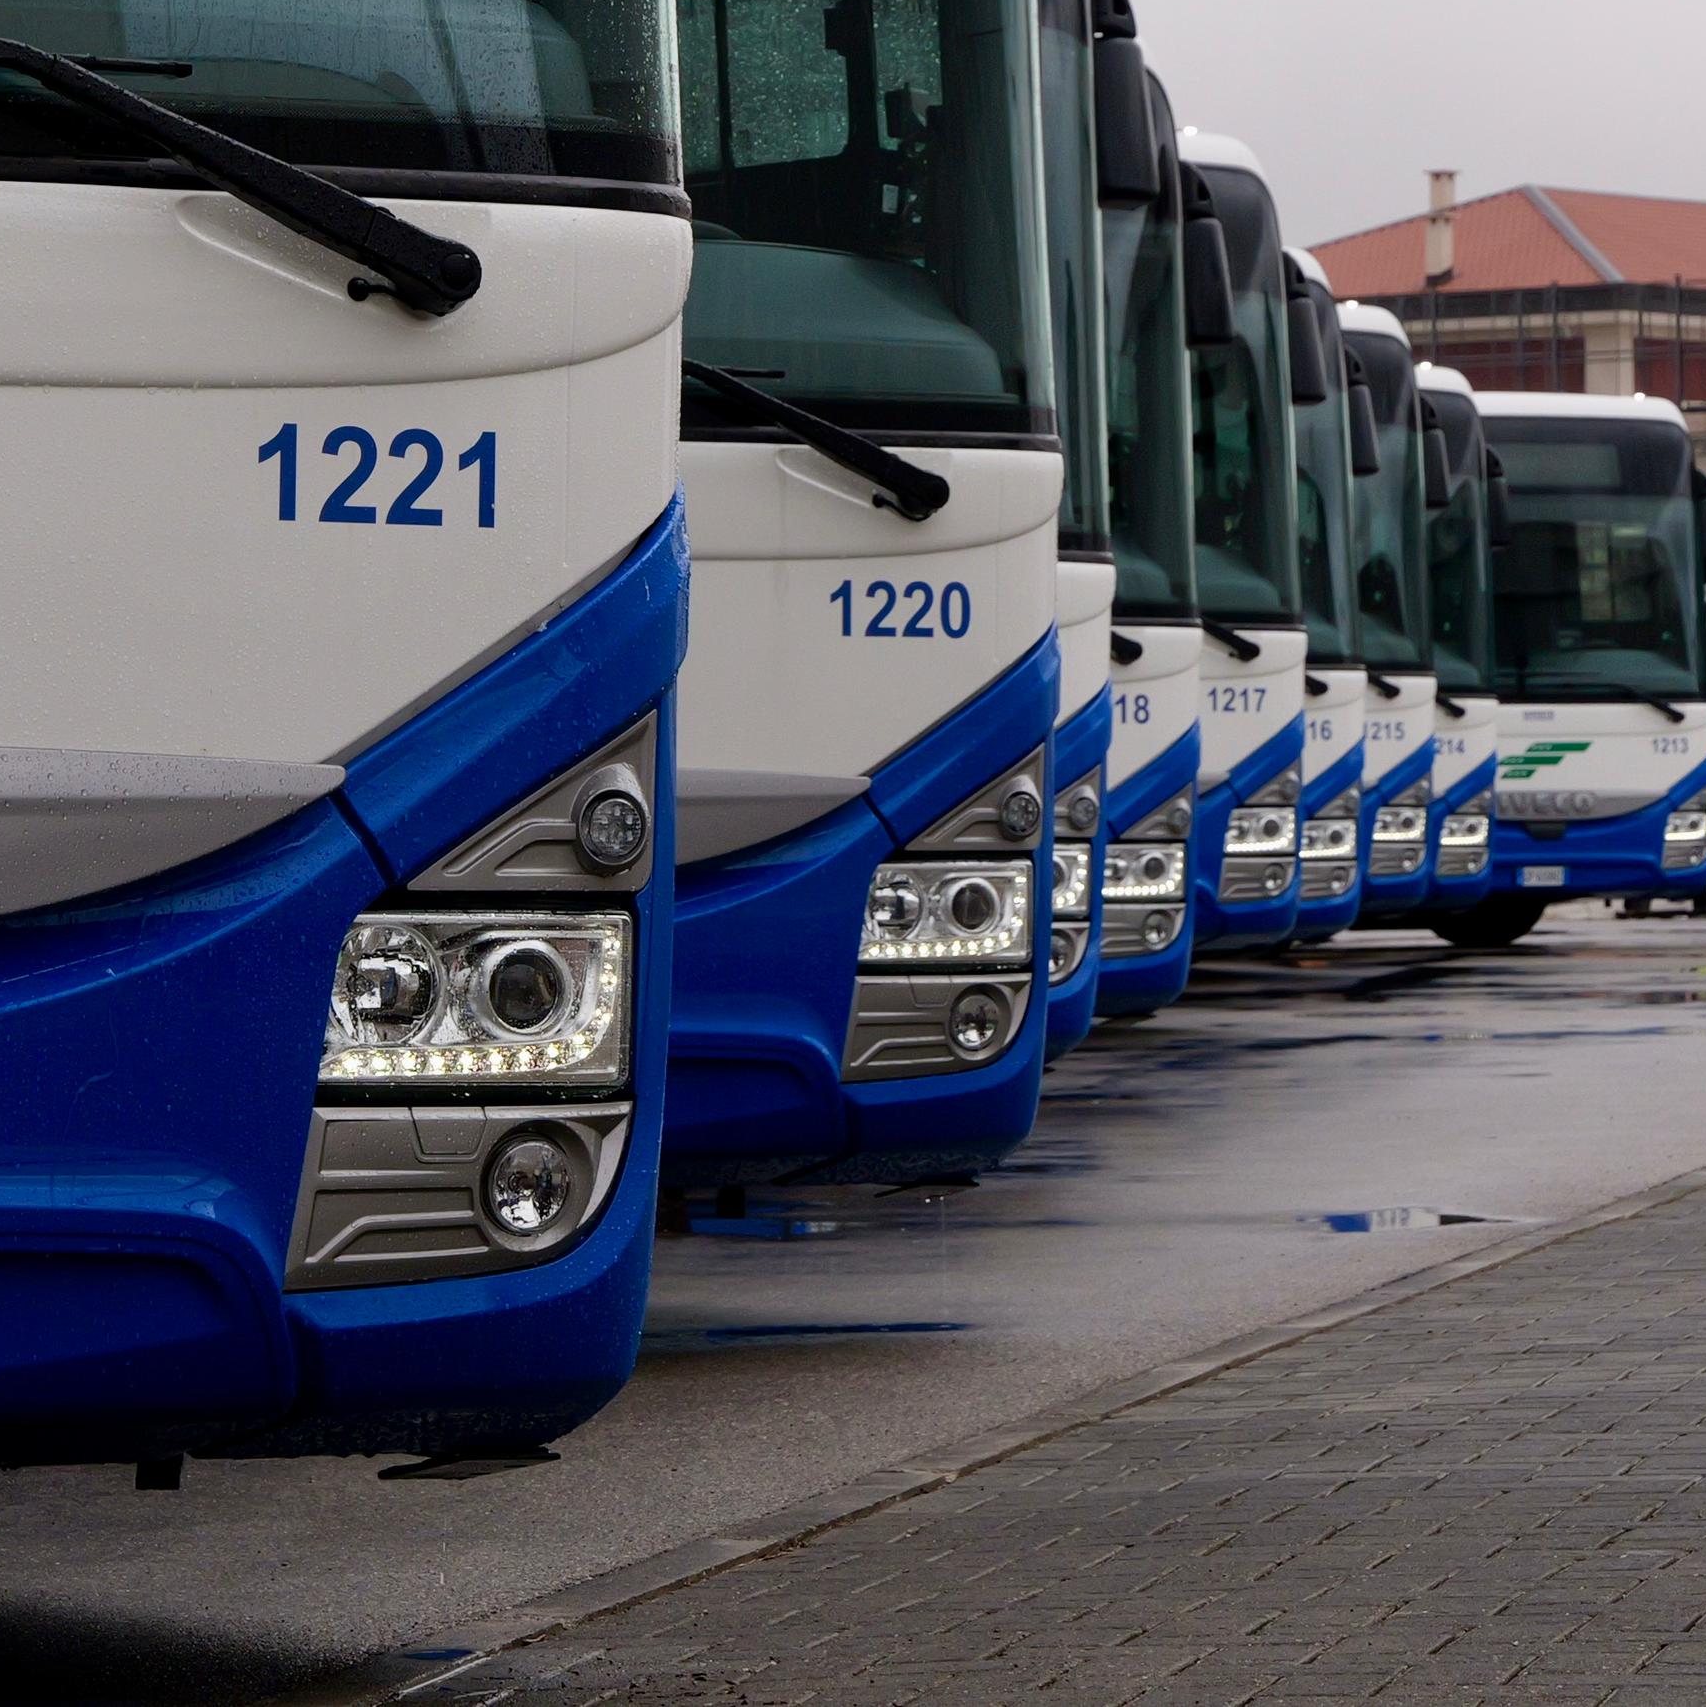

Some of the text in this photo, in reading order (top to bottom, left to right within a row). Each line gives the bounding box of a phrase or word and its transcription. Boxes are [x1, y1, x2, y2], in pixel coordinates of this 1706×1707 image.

[257, 422, 497, 529] 1221
[829, 579, 971, 639] 1220
[1115, 693, 1150, 725] 18
[1207, 686, 1268, 713] 1217
[1308, 719, 1334, 741] 16
[1435, 736, 1467, 755] 214
[1652, 737, 1690, 754] 1213
